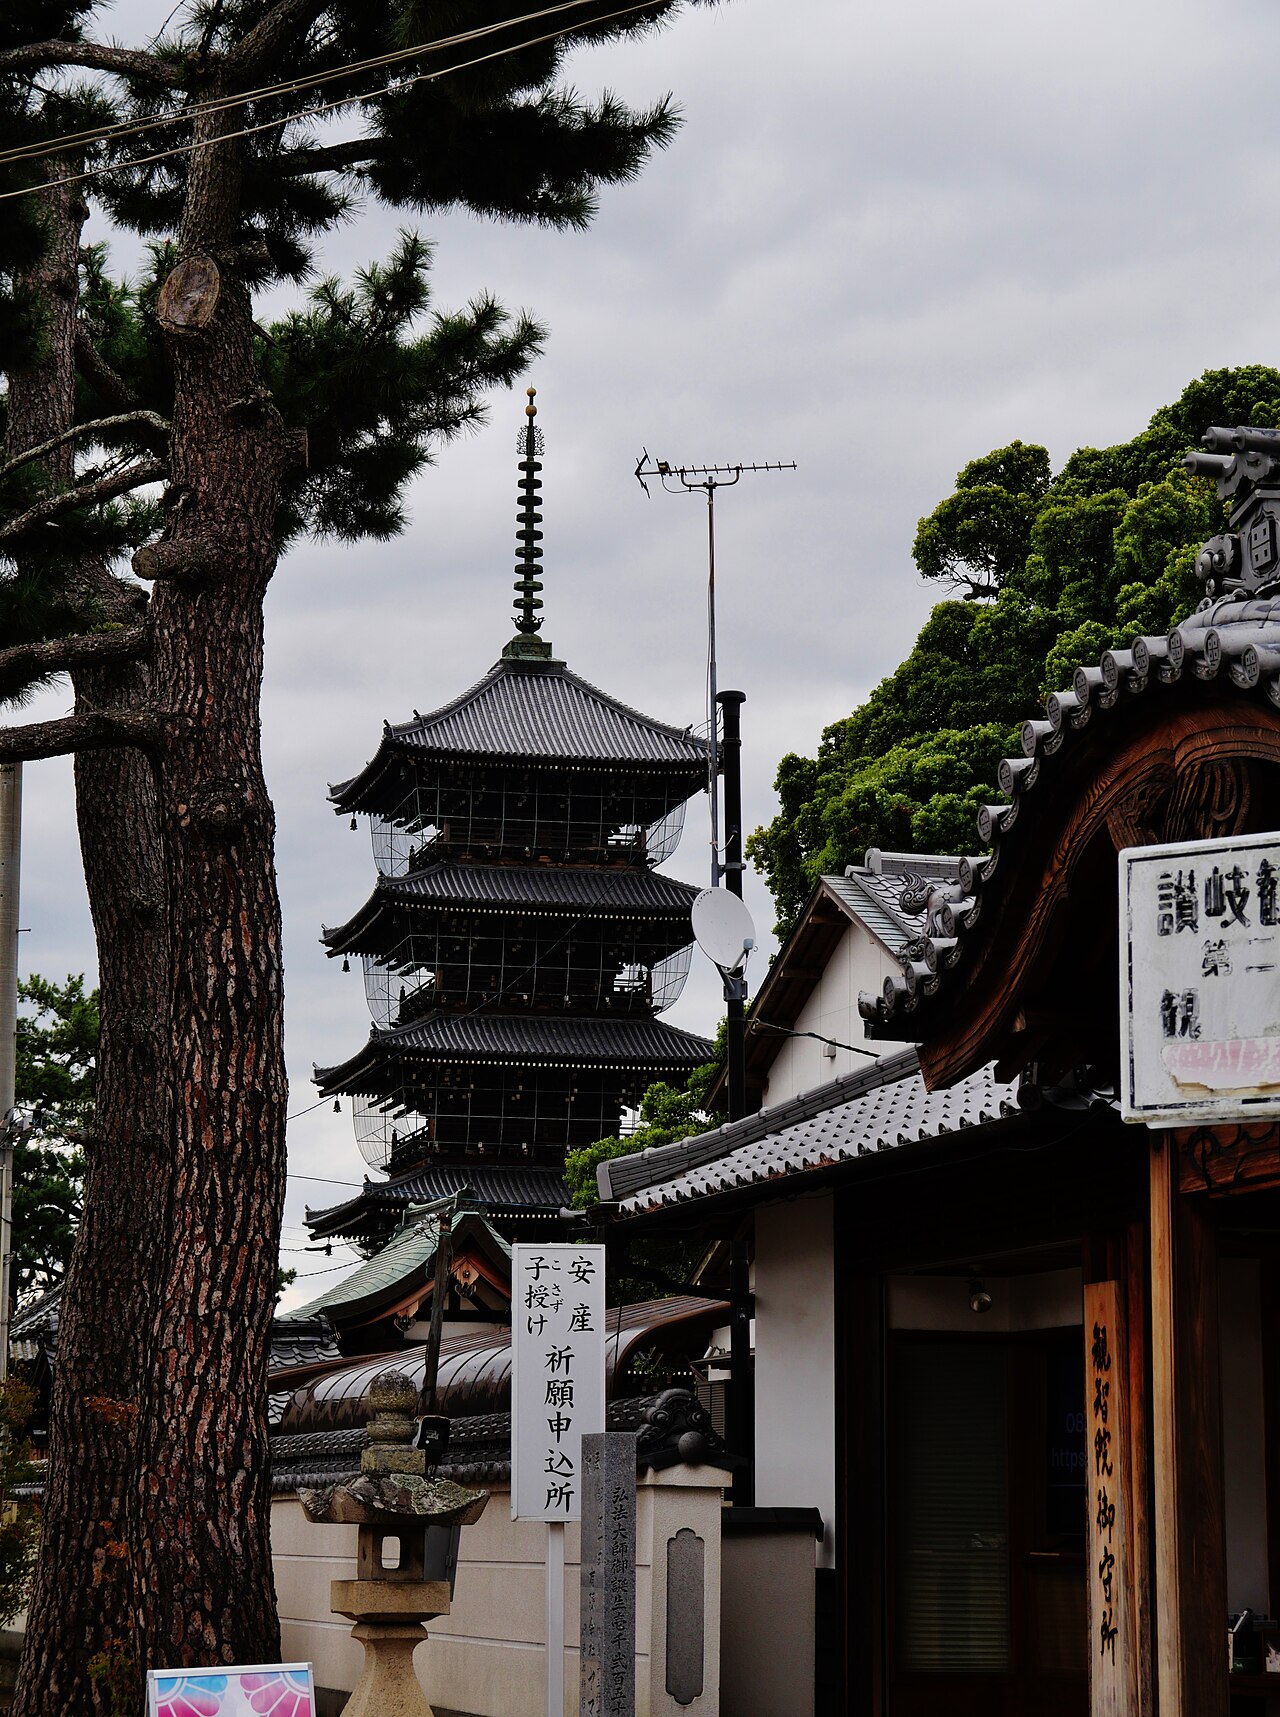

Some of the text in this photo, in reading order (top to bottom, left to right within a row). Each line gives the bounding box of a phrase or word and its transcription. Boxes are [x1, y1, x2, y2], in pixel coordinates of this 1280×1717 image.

[524, 1256, 550, 1337] 子授け
[567, 1255, 596, 1332] 安産
[543, 1344, 575, 1514] 祈願申込所
